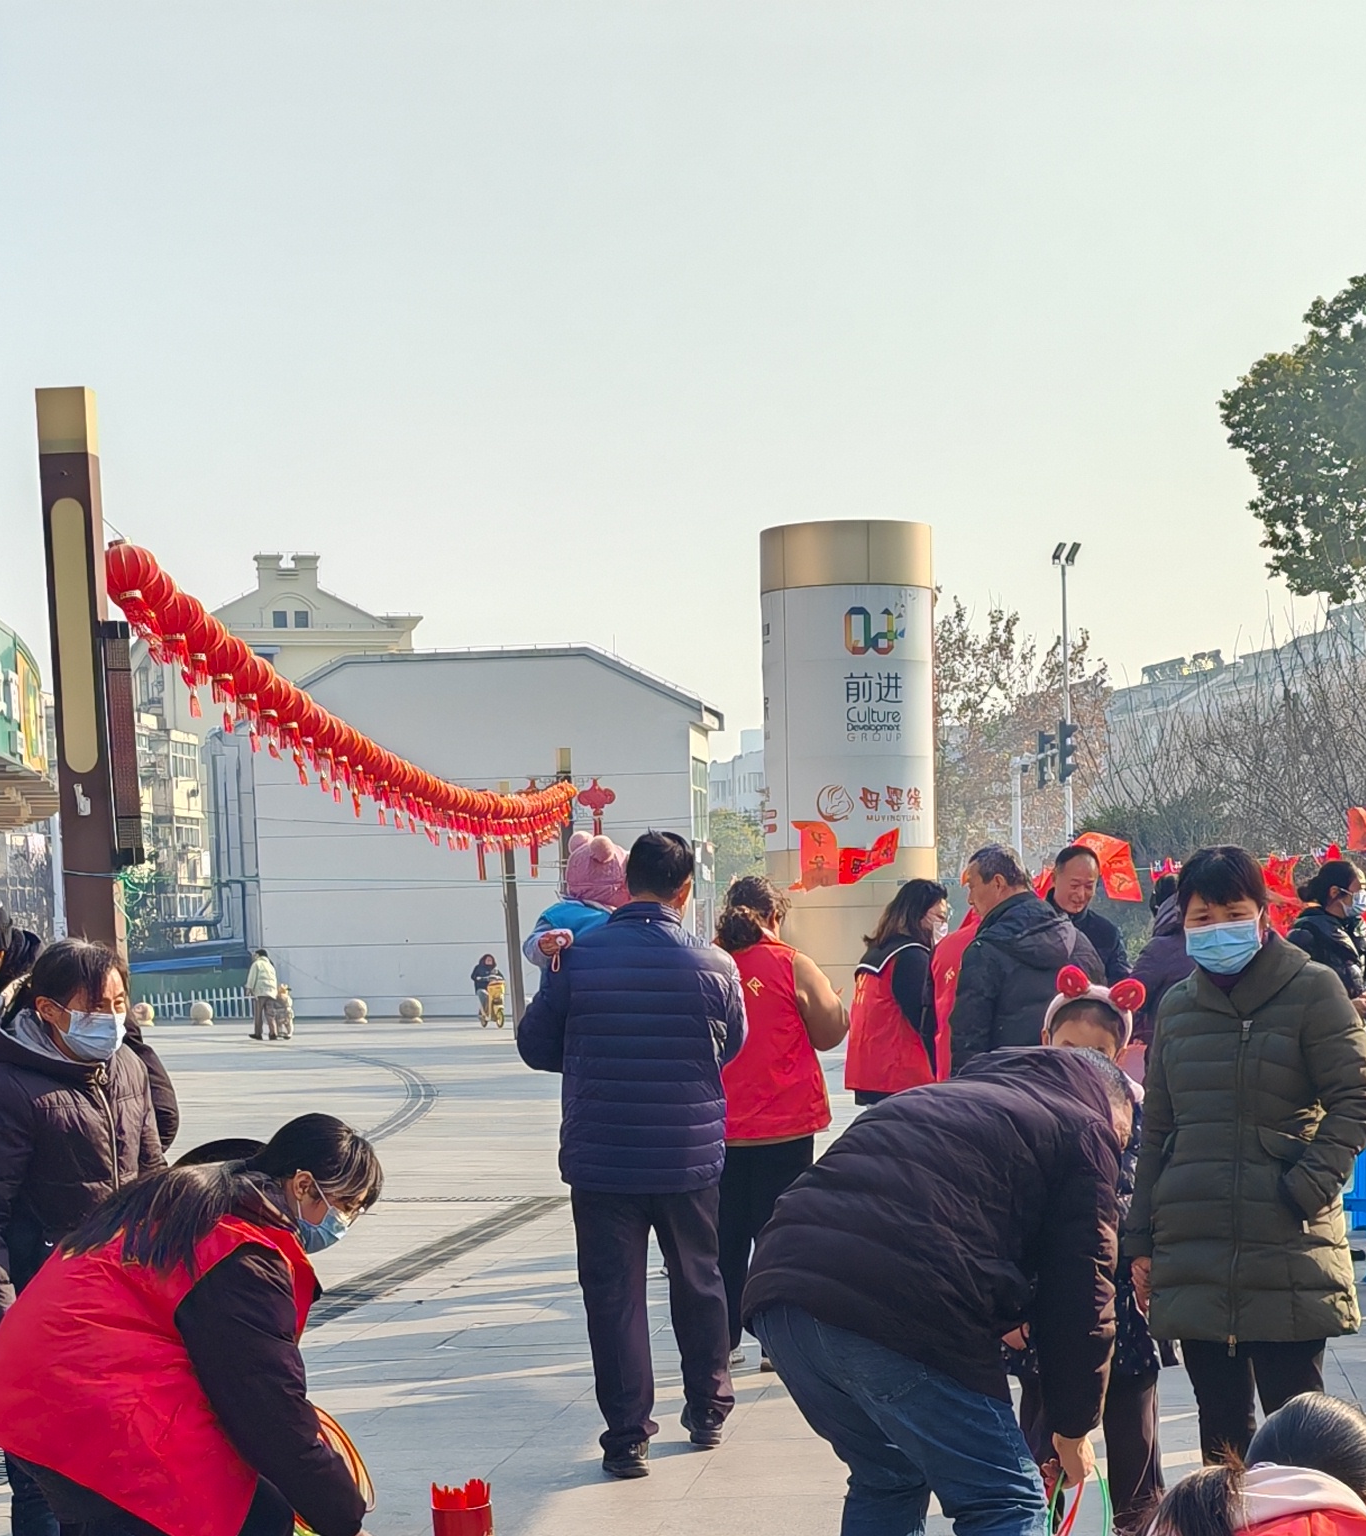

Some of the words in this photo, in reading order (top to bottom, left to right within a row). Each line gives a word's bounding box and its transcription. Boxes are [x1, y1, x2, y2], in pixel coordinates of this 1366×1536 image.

[843, 671, 904, 704] 前进
[845, 705, 902, 724] Culture
[846, 732, 903, 743] GROUP
[858, 785, 925, 812] 母婴缘
